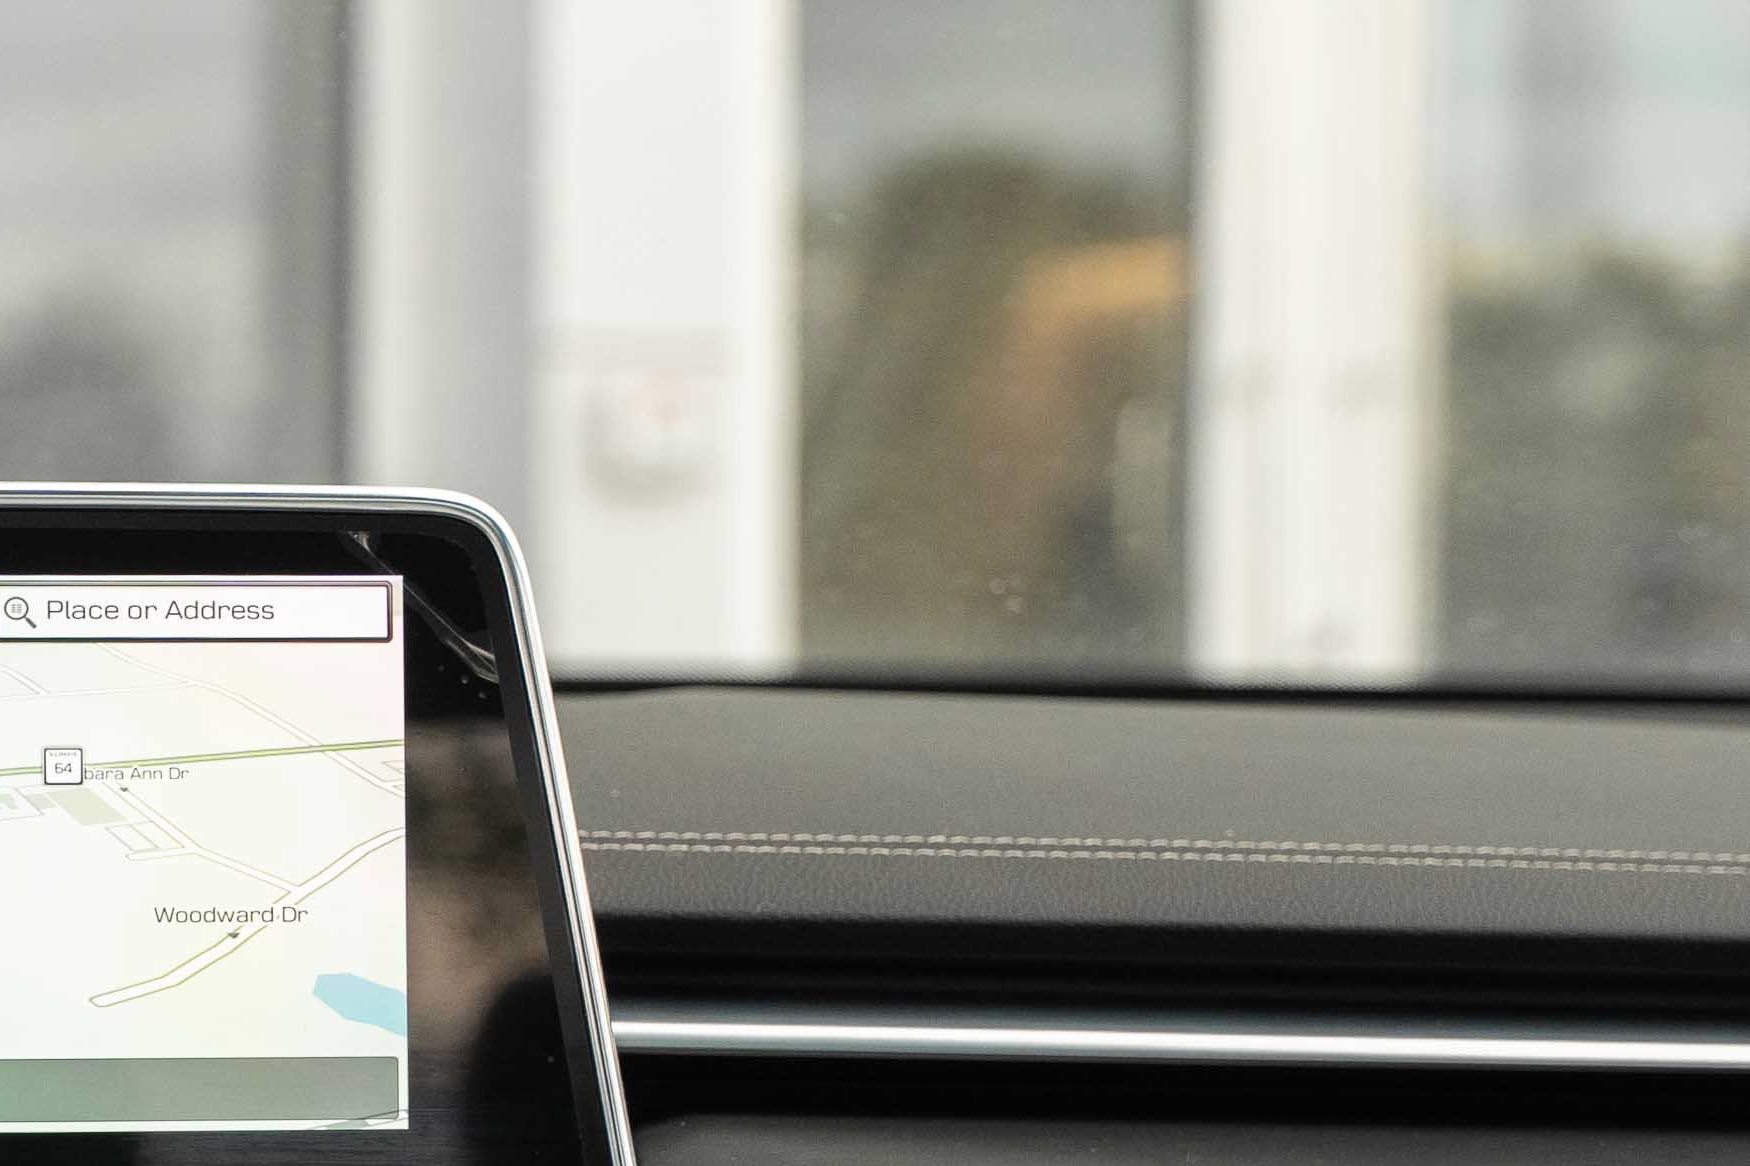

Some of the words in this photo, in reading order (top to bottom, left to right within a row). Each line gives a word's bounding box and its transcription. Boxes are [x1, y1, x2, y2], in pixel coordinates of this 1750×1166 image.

[46, 599, 120, 621] Place
[127, 605, 157, 621] or
[165, 599, 275, 621] Address
[54, 762, 72, 775] 64
[130, 767, 163, 780] Ann
[169, 767, 190, 780] Dr
[154, 907, 275, 924] Woodward
[282, 906, 309, 923] Dr
